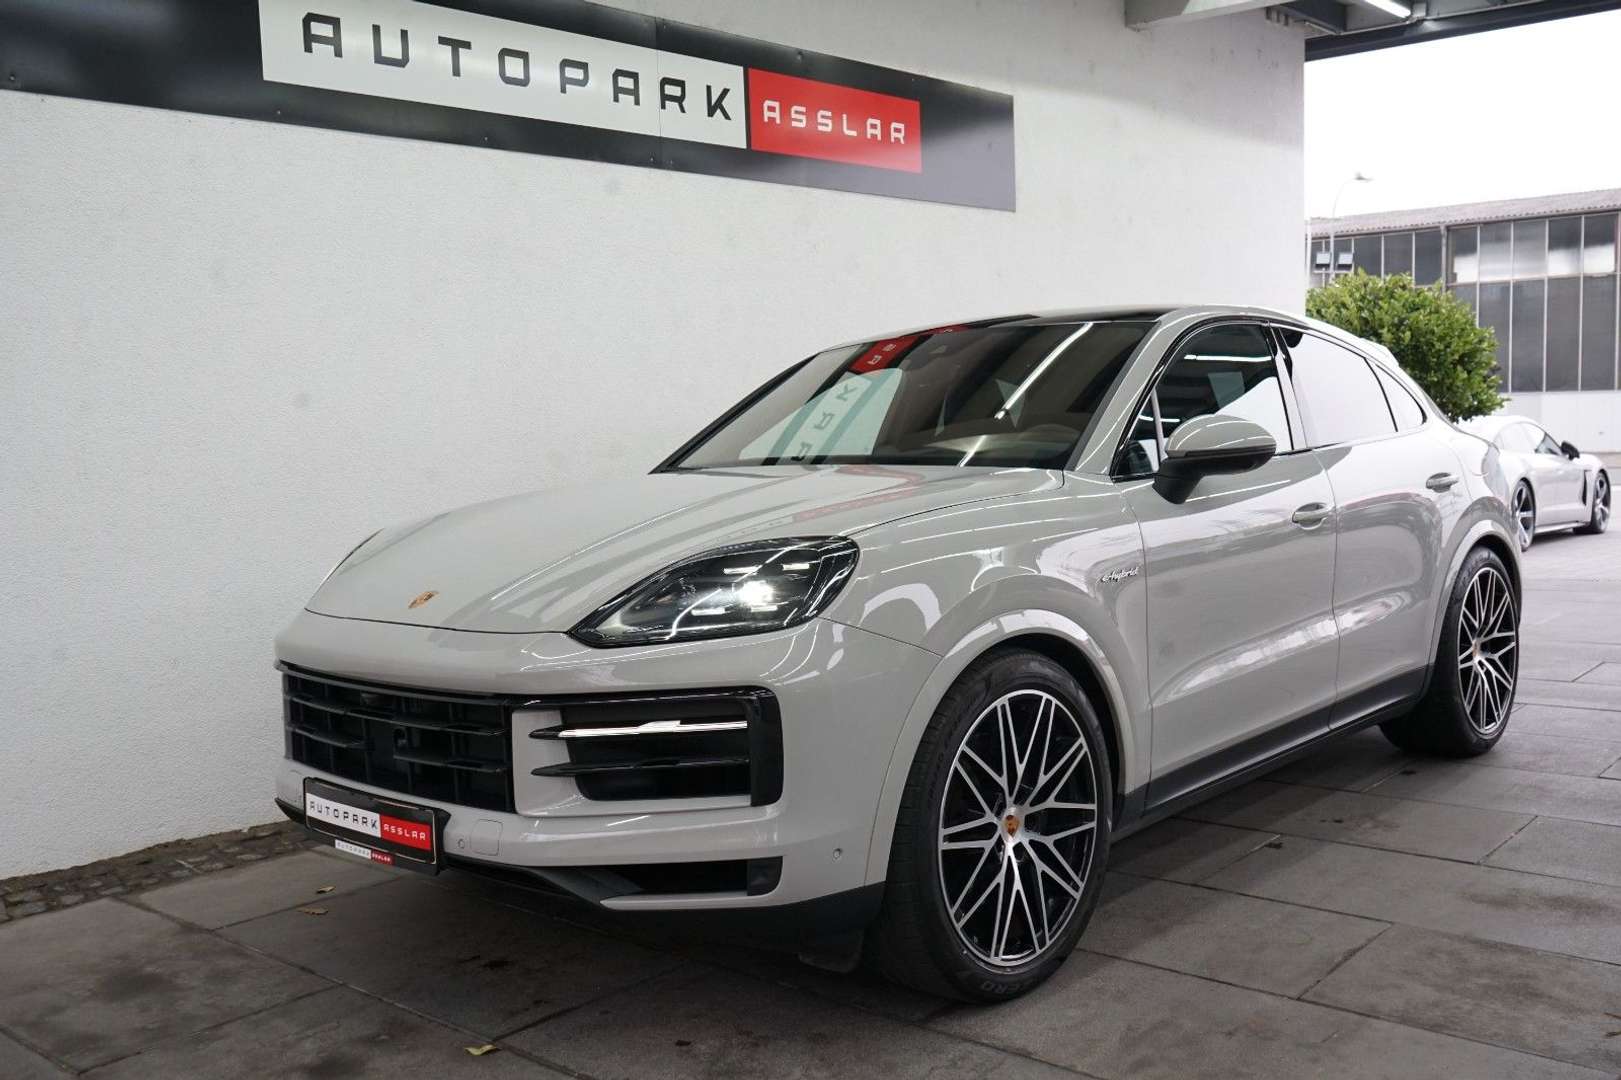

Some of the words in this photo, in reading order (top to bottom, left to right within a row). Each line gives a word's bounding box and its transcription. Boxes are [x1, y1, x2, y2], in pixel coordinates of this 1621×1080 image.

[302, 12, 732, 121] AUTOPARK
[762, 99, 906, 145] ASSLAR
[309, 800, 378, 830] AUTOPARK
[383, 823, 427, 841] ASSLAR
